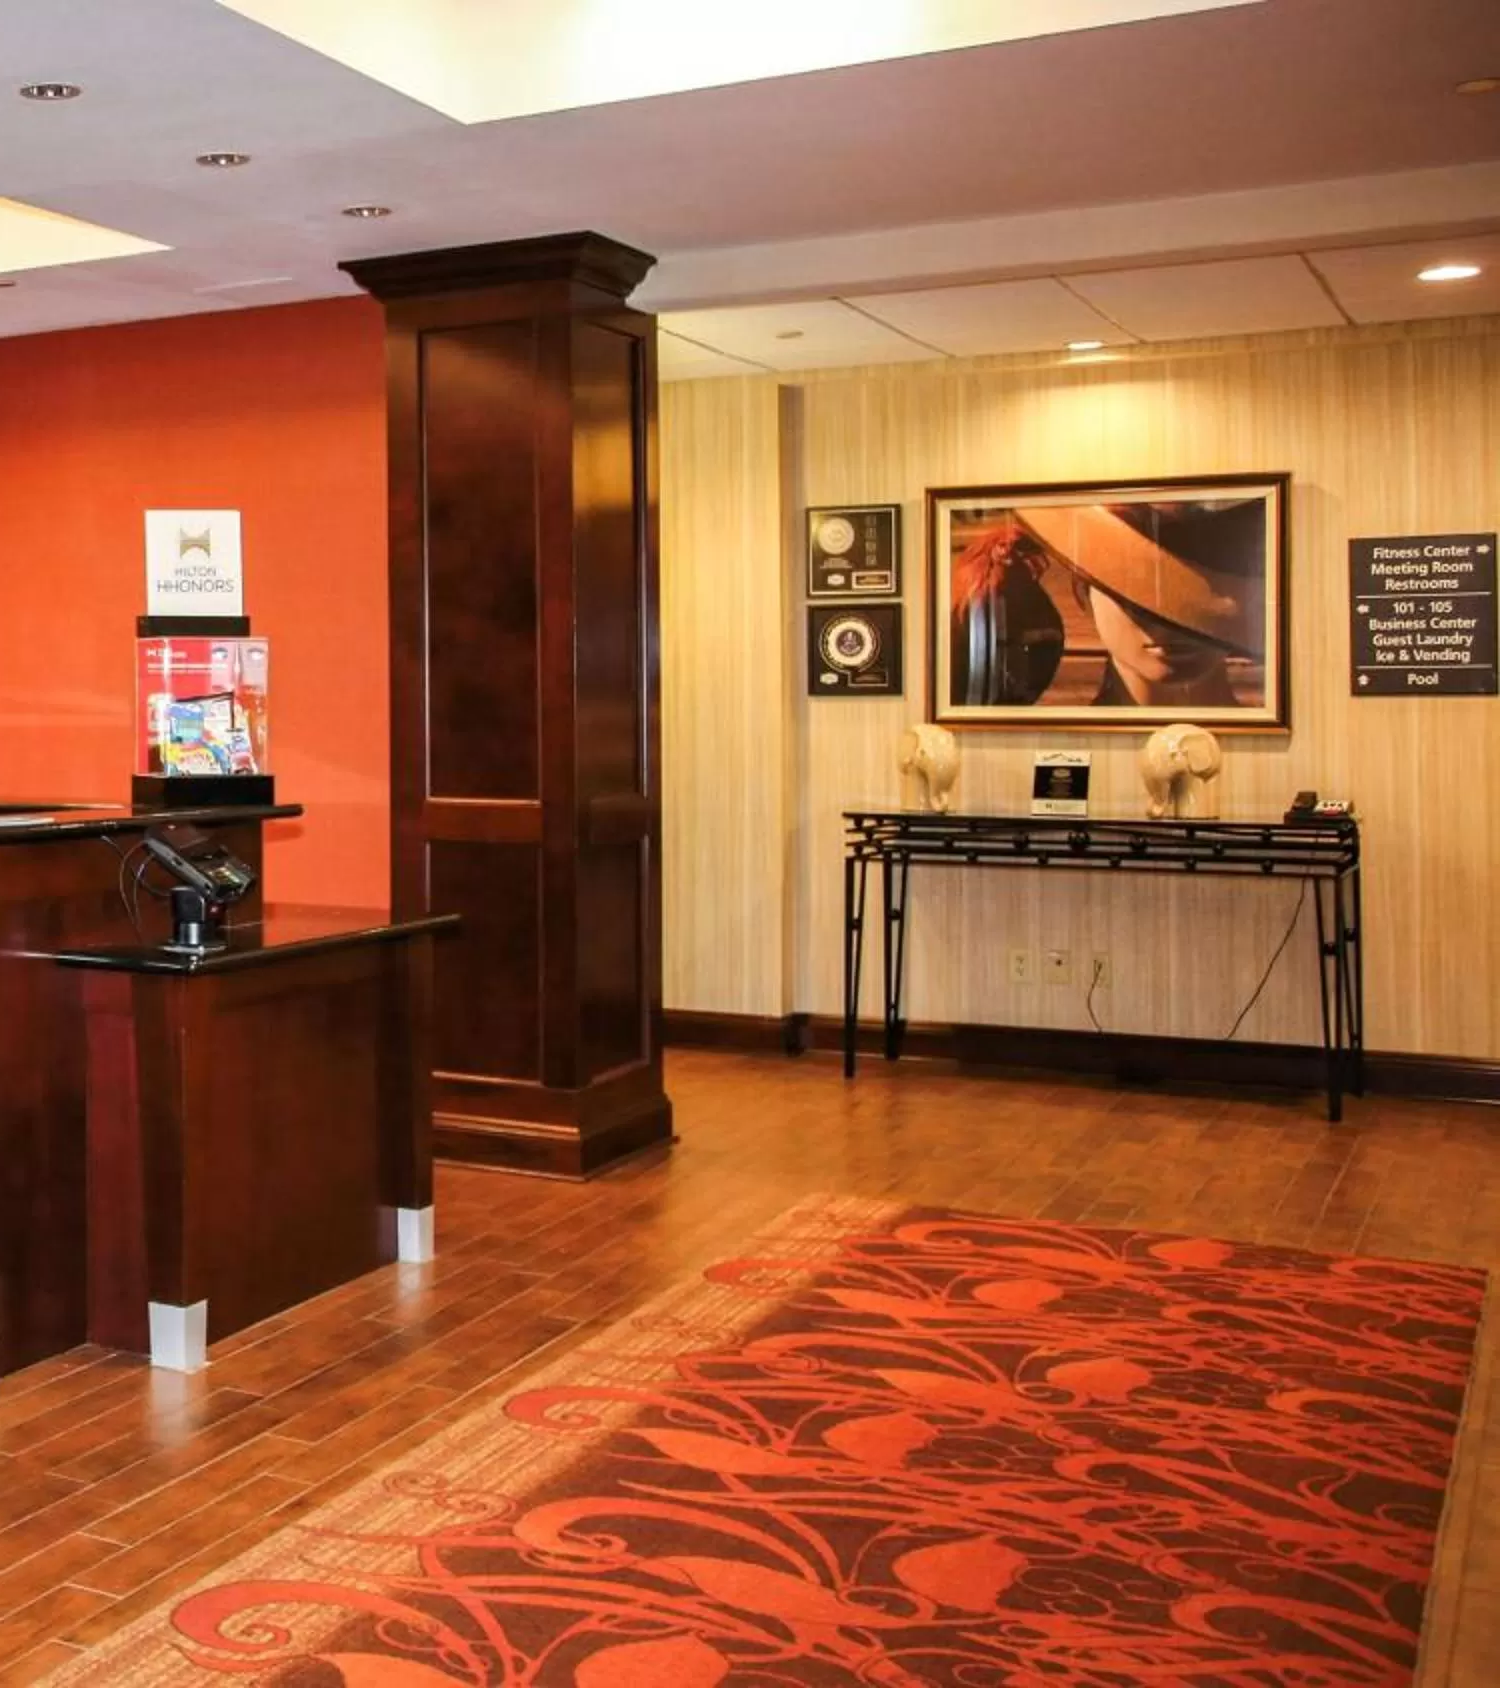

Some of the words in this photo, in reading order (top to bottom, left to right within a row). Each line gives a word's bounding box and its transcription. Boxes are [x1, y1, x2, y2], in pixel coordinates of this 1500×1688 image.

[1373, 546, 1420, 559] Fitness
[1423, 545, 1470, 558] Center
[173, 566, 217, 577] HILTON
[1371, 561, 1428, 576] Meeting
[1431, 561, 1473, 573] Room
[156, 578, 235, 593] HHONORS
[1385, 578, 1459, 591] Restrooms
[1393, 602, 1415, 614] 101
[1429, 602, 1452, 613] 105
[1369, 617, 1426, 631] Business
[1430, 617, 1477, 629] Center
[1372, 633, 1413, 646] Guest
[1417, 632, 1473, 647] Laundry
[1376, 650, 1395, 662] Ice
[1399, 649, 1410, 661] &
[1413, 648, 1471, 664] Vending
[1407, 673, 1439, 685] Pool
